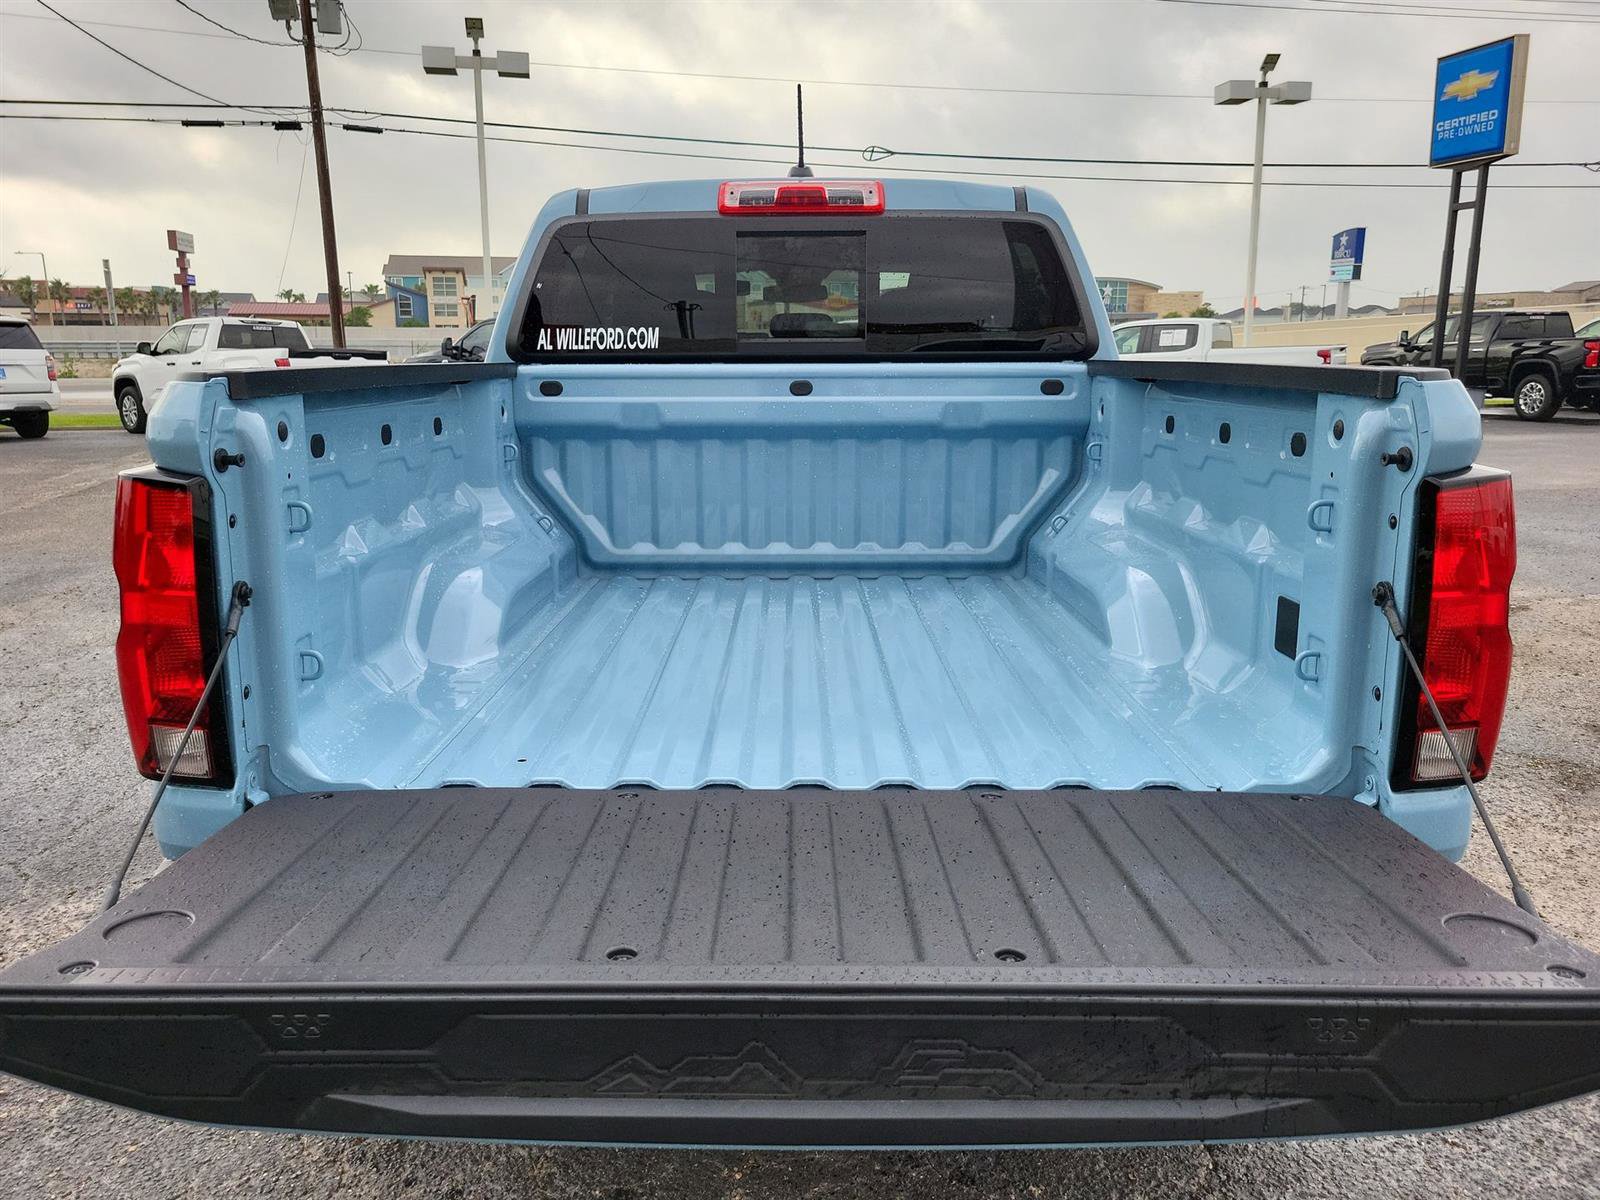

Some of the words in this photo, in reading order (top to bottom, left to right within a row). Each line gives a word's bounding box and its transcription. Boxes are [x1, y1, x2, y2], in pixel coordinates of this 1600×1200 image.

[1436, 109, 1498, 131] CERTIFIED
[1438, 121, 1494, 140] PRE-OWNED
[537, 328, 553, 350] AL
[556, 327, 660, 350] WILLEFORD.COM
